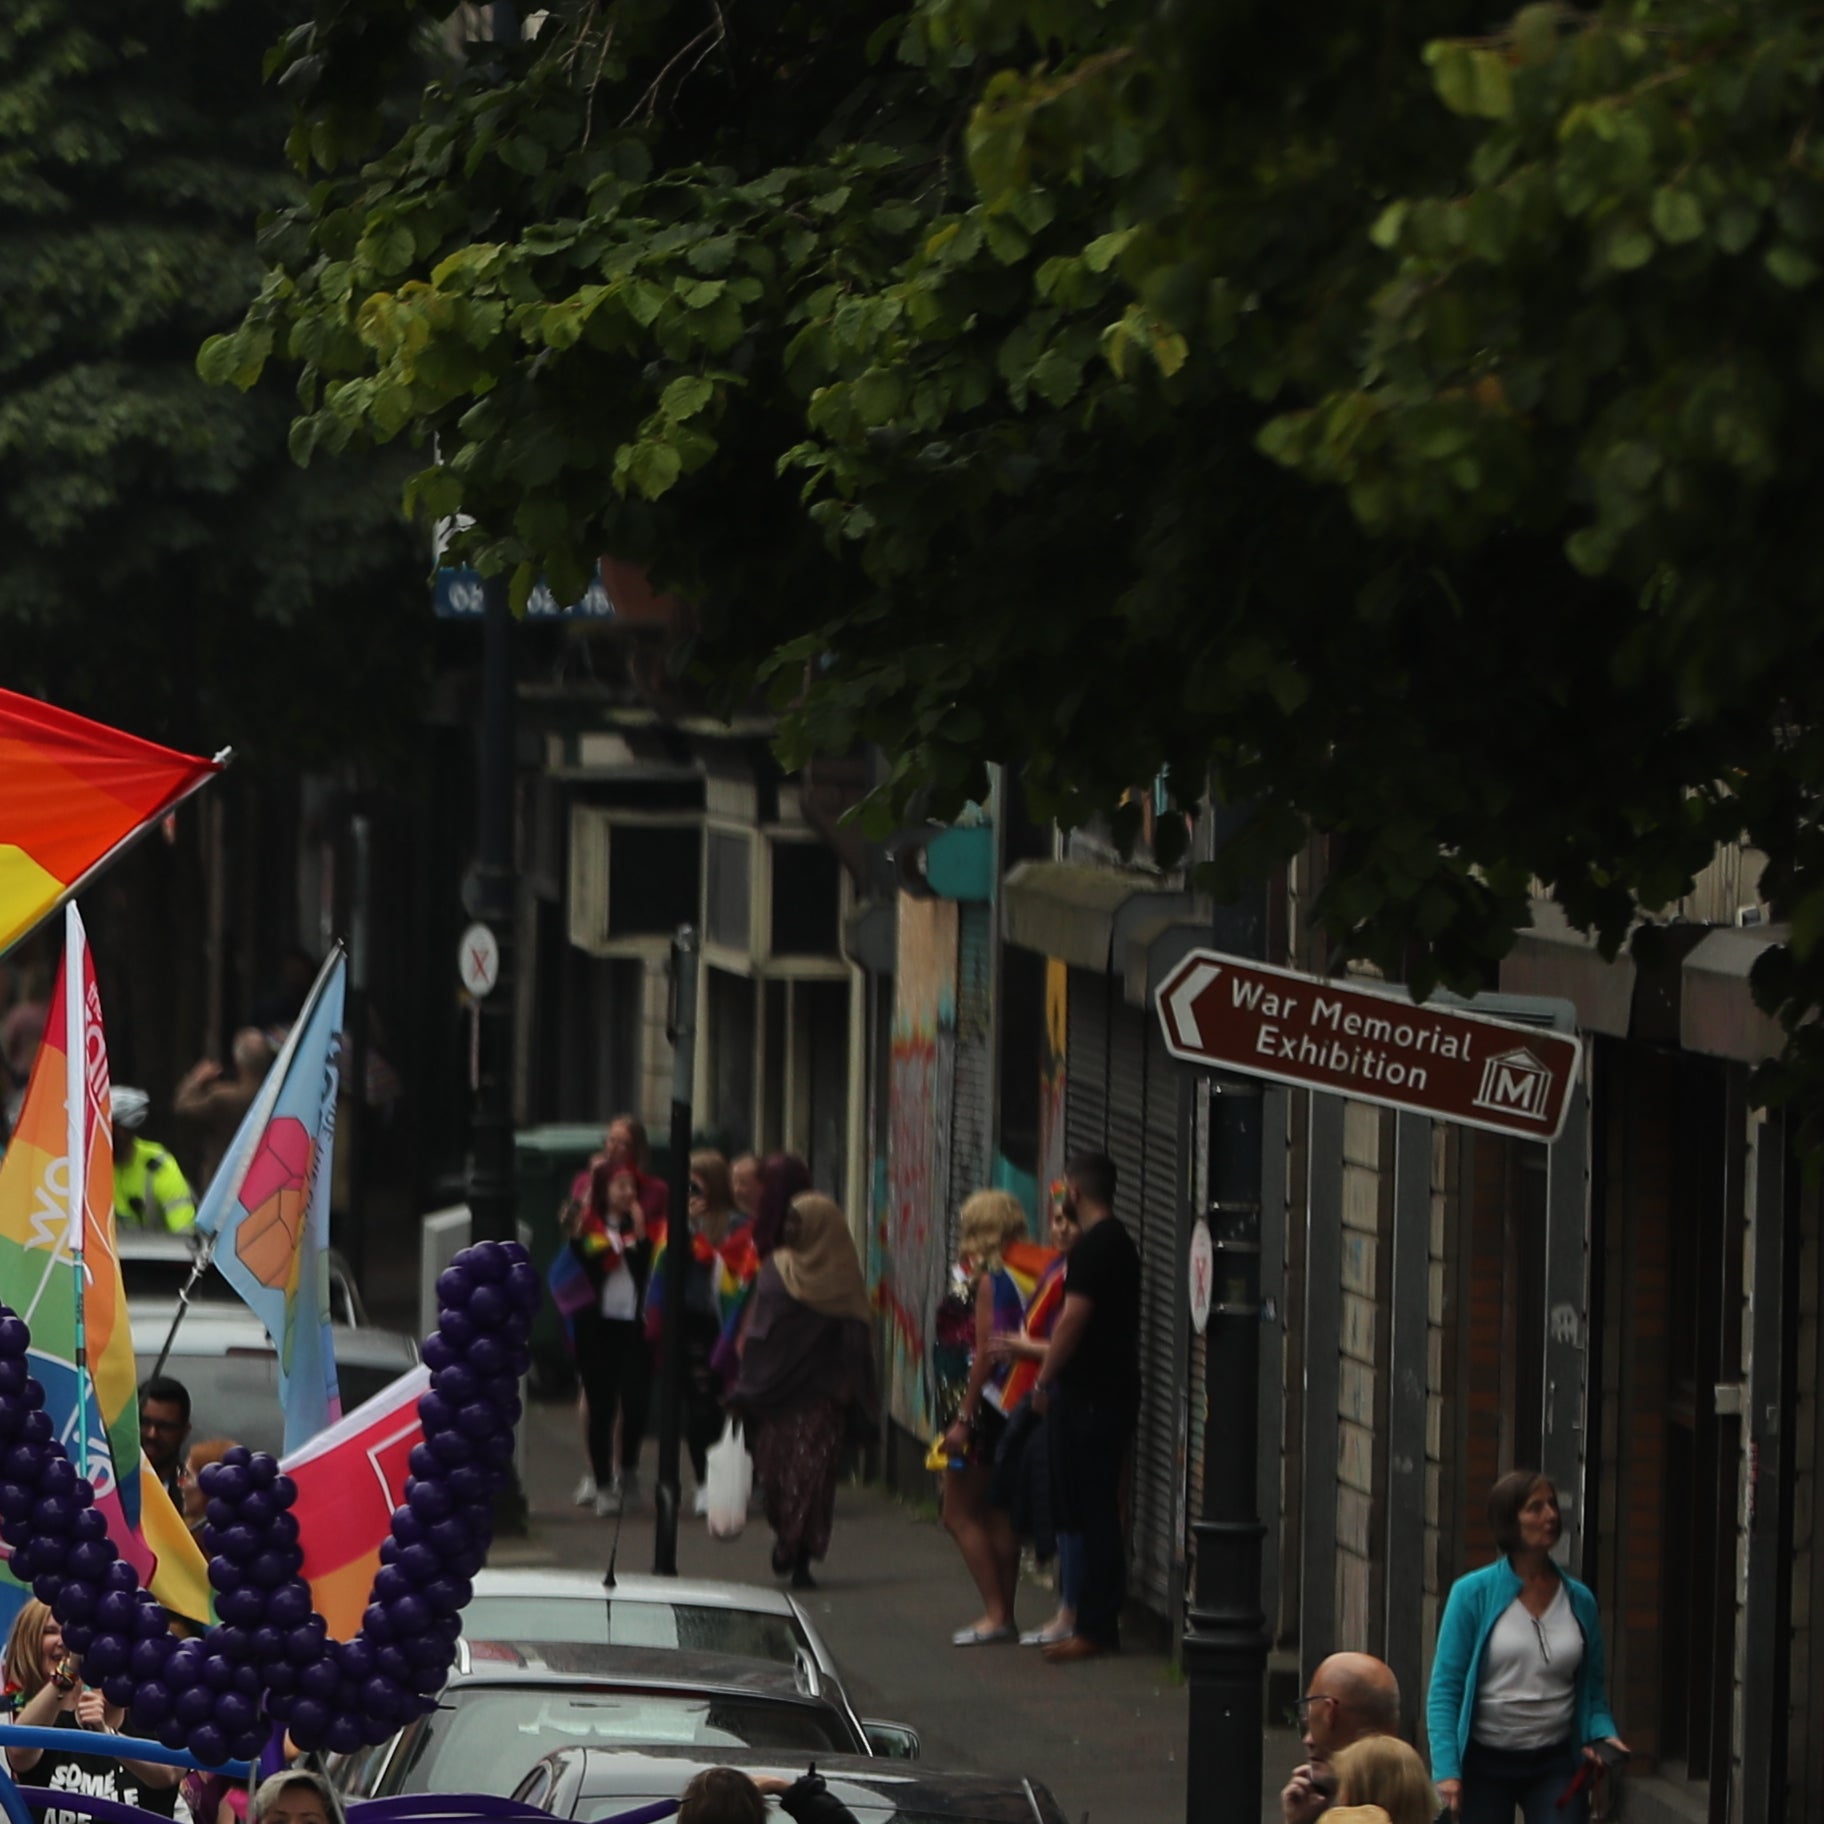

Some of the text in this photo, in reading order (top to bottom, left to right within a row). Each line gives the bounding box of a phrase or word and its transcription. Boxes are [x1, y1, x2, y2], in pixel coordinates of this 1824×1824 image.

[1231, 976, 1472, 1063] War Memorial
[1255, 1023, 1428, 1091] Exhibition
[51, 1762, 116, 1798] SOME
